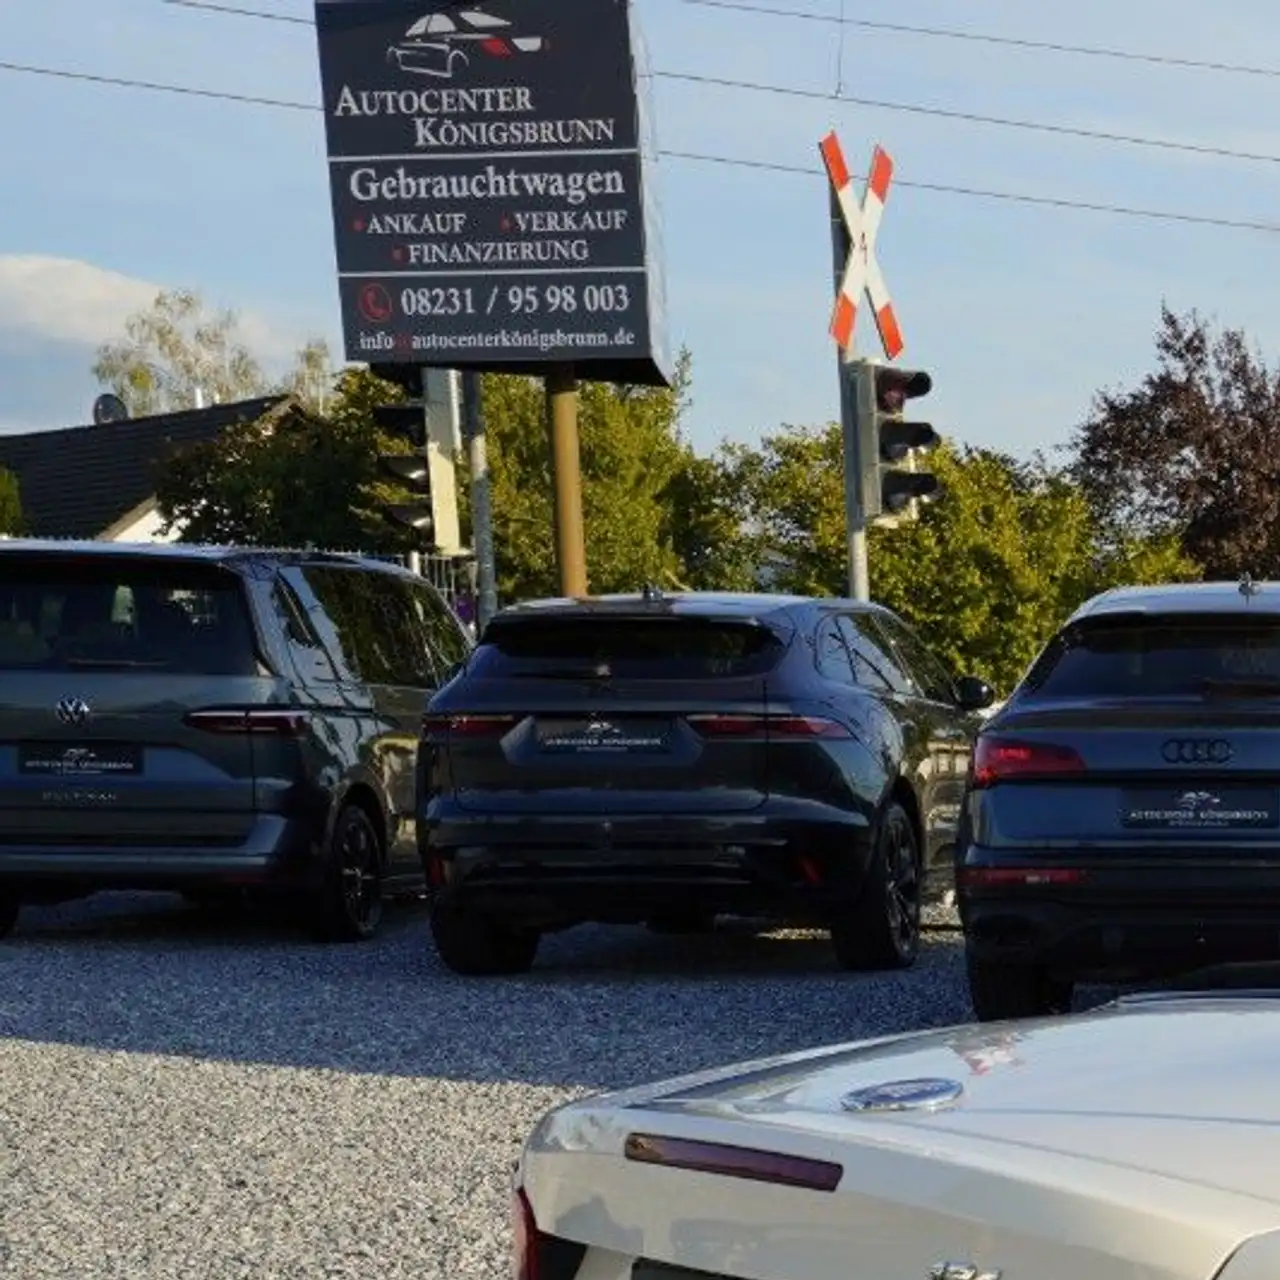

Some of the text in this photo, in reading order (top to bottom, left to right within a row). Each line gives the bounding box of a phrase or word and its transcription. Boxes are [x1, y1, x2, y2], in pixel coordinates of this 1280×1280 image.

[334, 85, 534, 116] AUTOCENTER
[412, 116, 616, 147] KÖNIGSBRUNN
[349, 166, 626, 204] Gebrauchtwagen
[366, 209, 628, 234] ANKAUF VERKAUF
[408, 240, 589, 264] FINANZIERUNG
[400, 285, 630, 315] 08231 / 95 98 003
